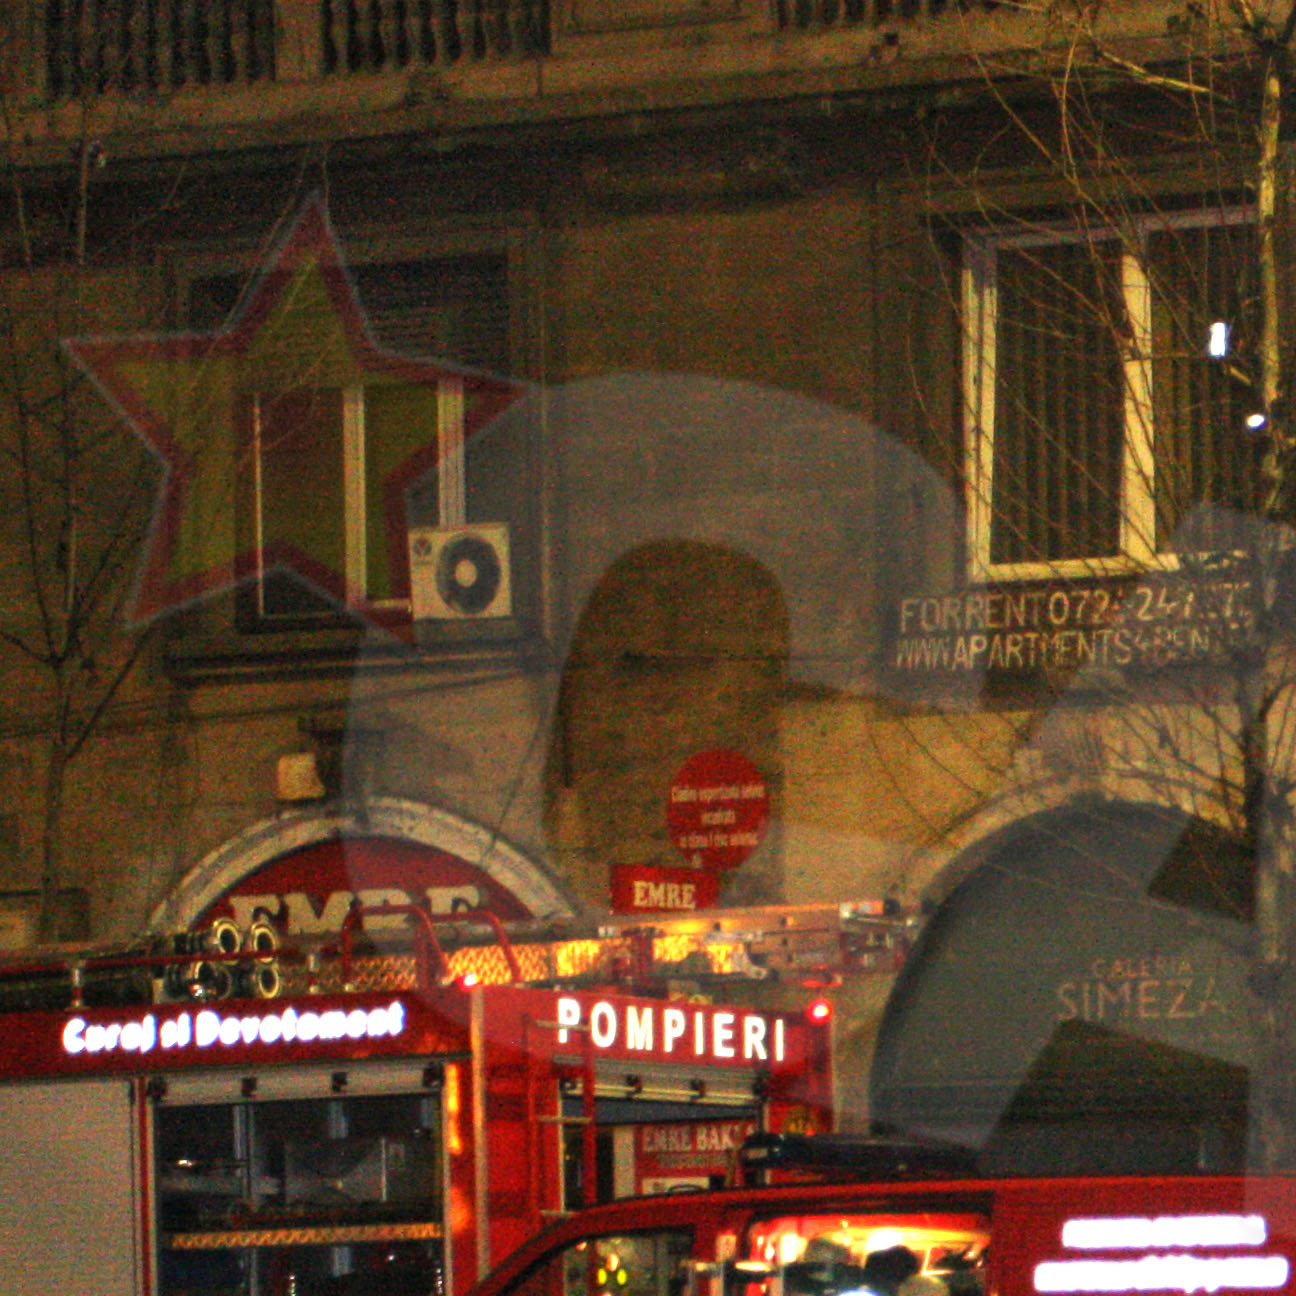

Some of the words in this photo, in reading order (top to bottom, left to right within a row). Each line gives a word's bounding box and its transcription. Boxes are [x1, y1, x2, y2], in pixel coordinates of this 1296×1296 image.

[633, 881, 697, 909] EMRE
[1056, 976, 1227, 1021] SIMEZA
[557, 998, 785, 1062] POMPIERI
